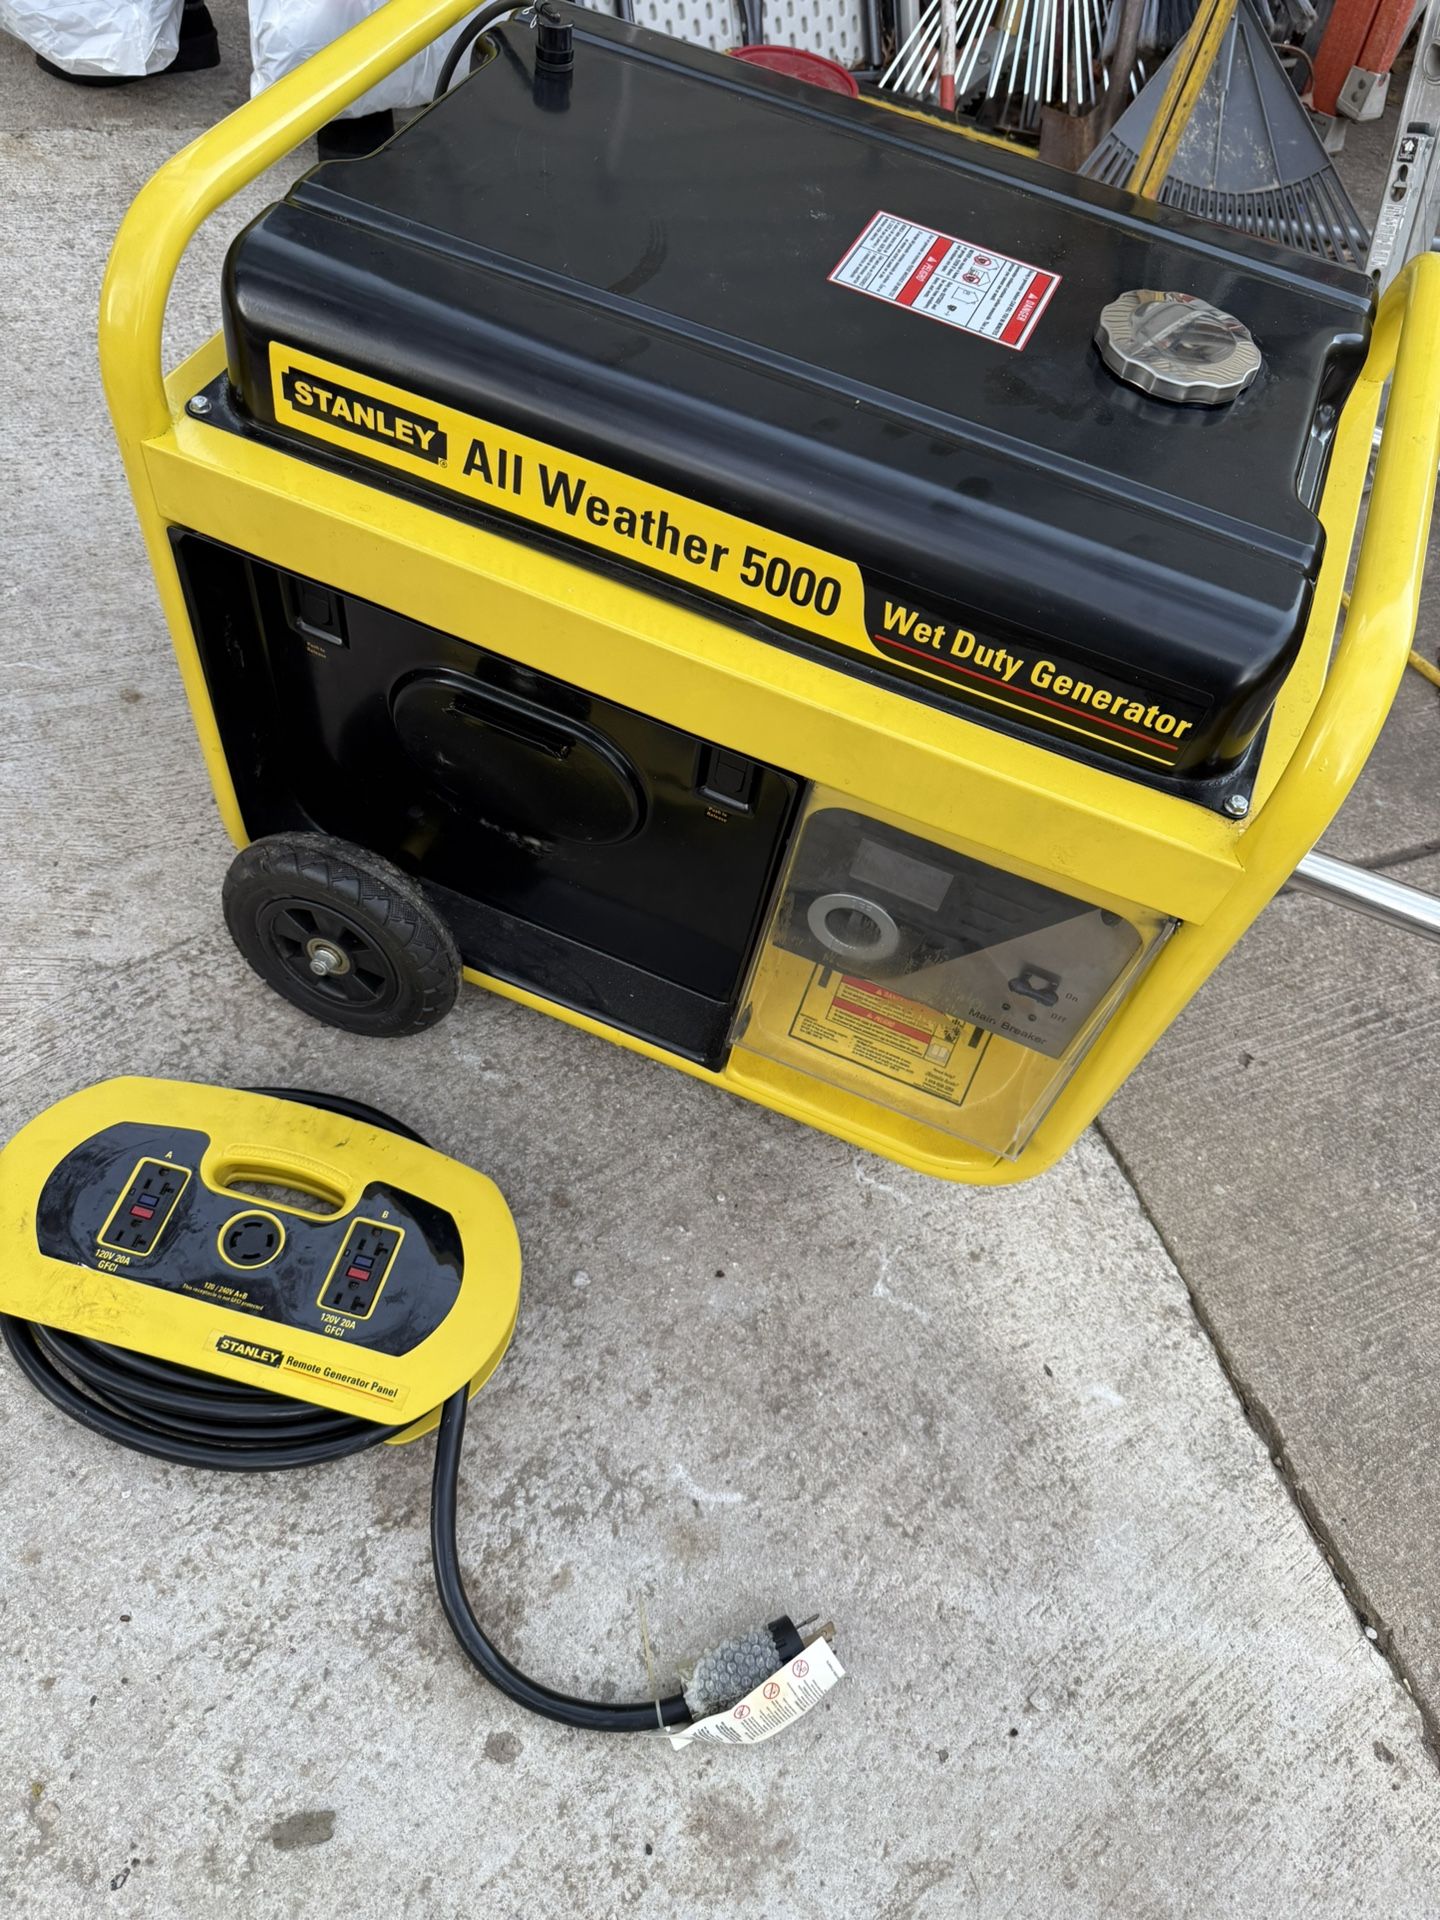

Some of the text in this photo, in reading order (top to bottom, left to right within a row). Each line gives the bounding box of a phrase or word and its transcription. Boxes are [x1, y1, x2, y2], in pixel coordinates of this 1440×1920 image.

[1016, 299, 1035, 321] DANGER
[294, 381, 436, 450] STANLEY
[462, 438, 841, 616] All Weather 5000
[883, 601, 1193, 739] Wet Duty Generator
[1065, 993, 1079, 1002] On
[969, 1008, 1048, 1046] Main Breaker
[165, 1151, 173, 1159] A
[381, 1210, 389, 1219] B
[95, 1249, 131, 1265] 120V 20A
[97, 1260, 119, 1272] GFCI
[204, 1281, 216, 1290] 120
[233, 1290, 249, 1300] A+B
[320, 1312, 356, 1329] 120V 20A
[324, 1324, 345, 1337] GFCI
[220, 1339, 399, 1398] STANLEY Remote Generator Panel
